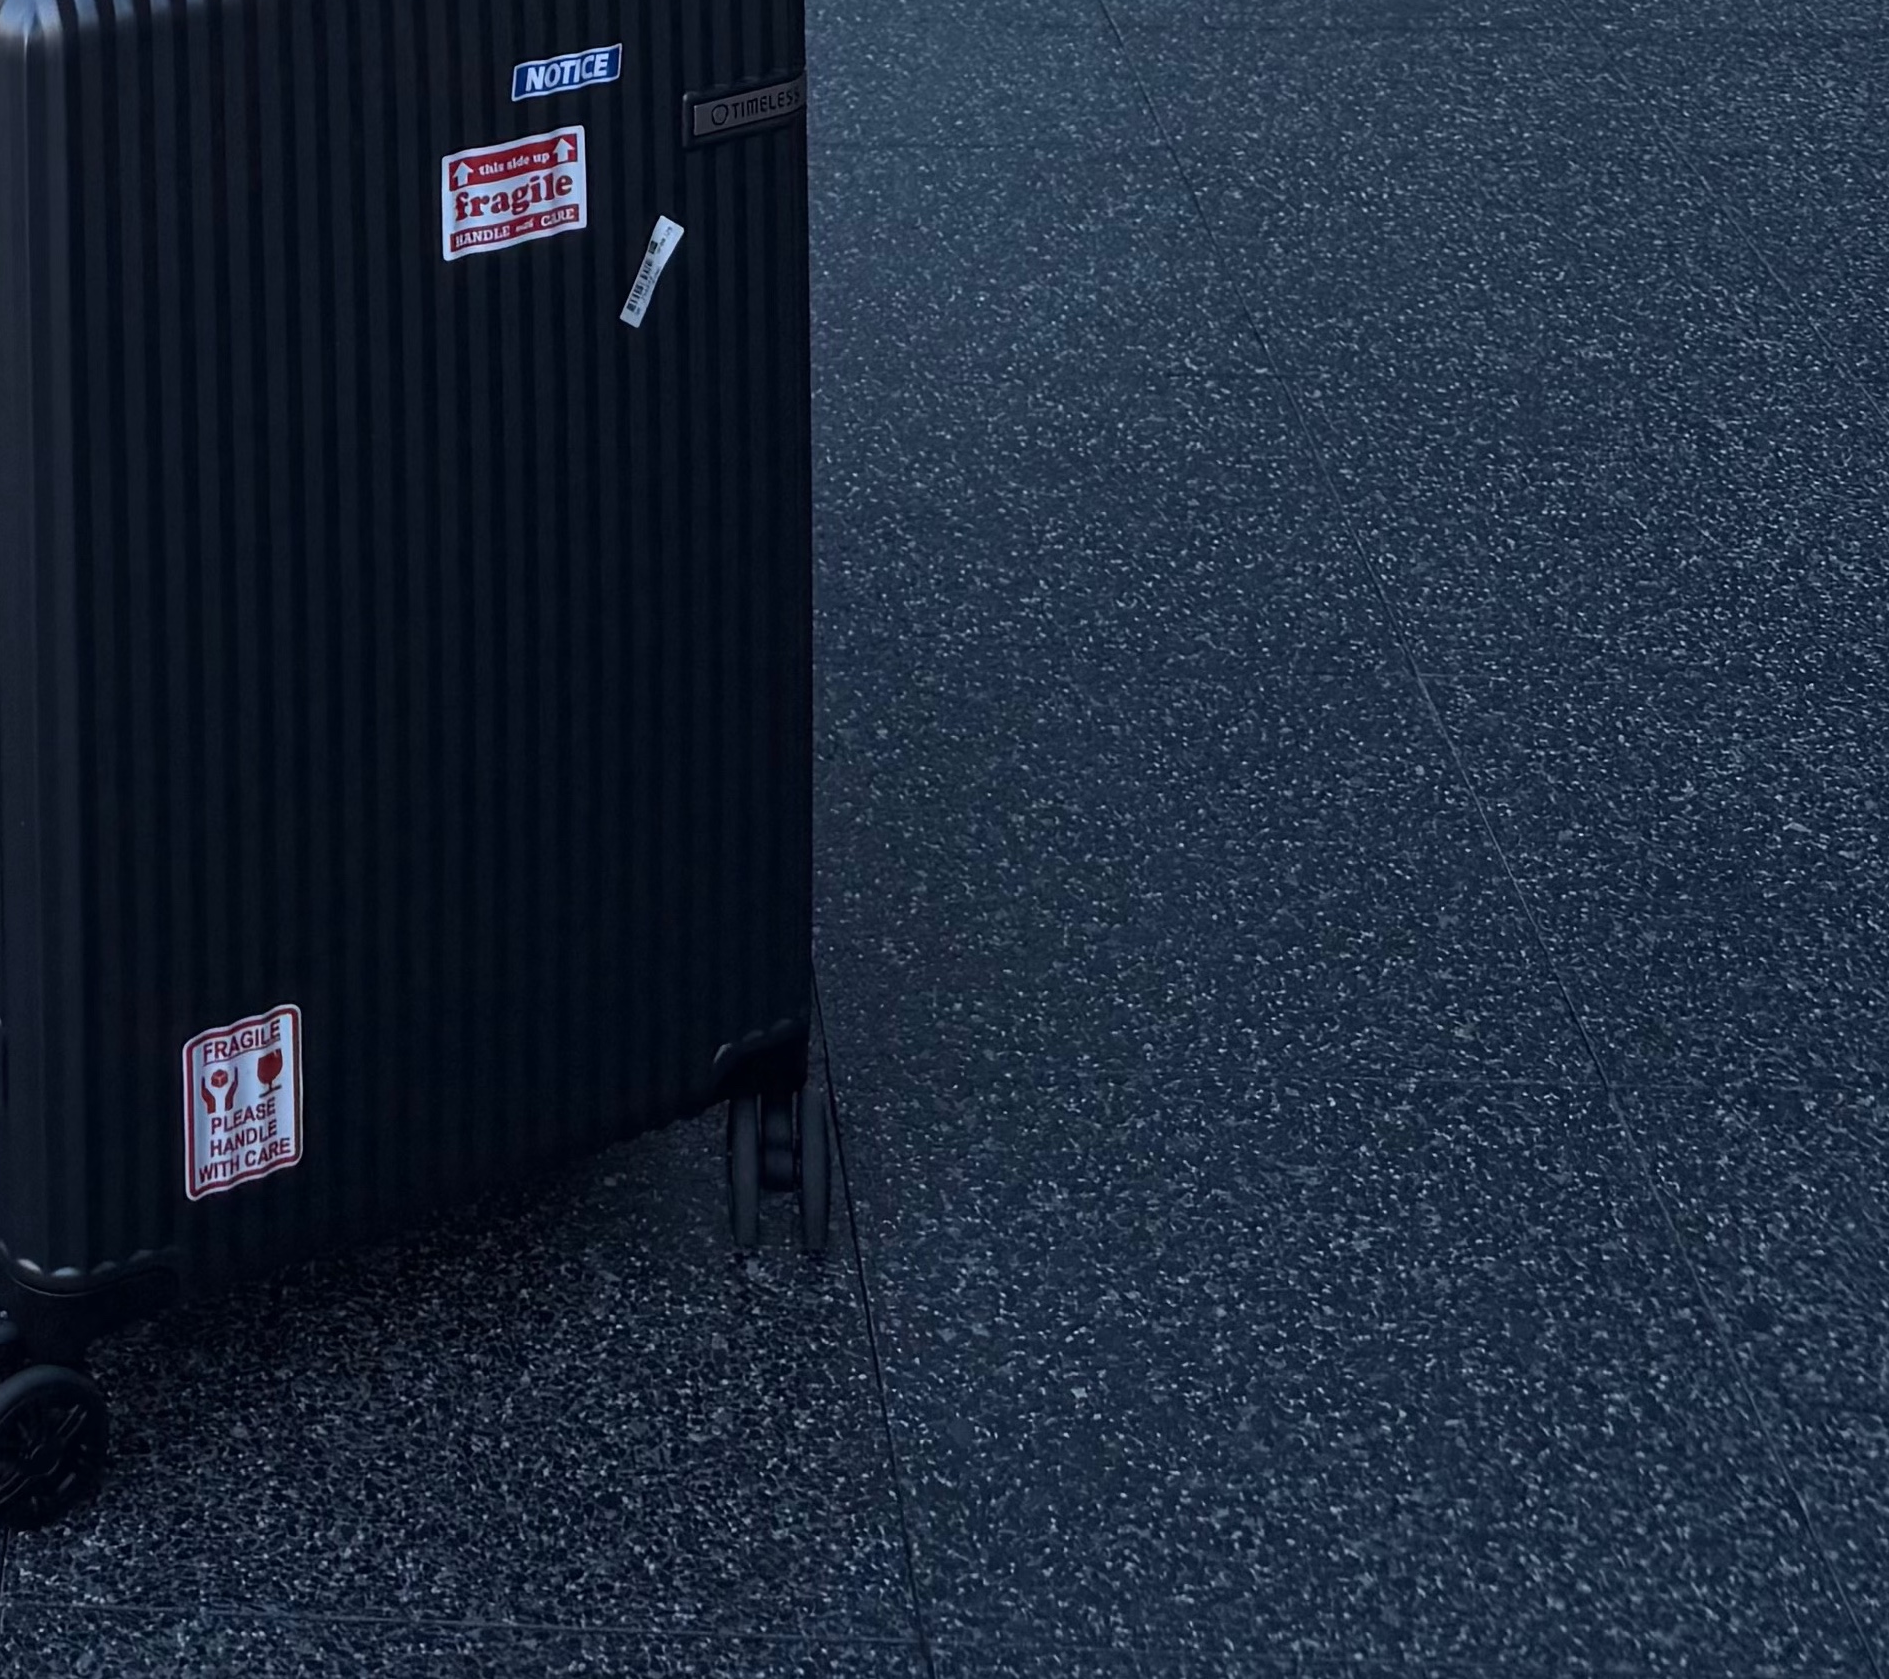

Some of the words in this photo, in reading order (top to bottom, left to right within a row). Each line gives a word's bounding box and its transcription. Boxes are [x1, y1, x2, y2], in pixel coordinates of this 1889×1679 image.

[525, 52, 609, 92] NOTICE
[479, 162, 504, 176] this
[507, 155, 529, 169] side
[533, 152, 550, 165] up
[455, 172, 573, 223] fragile
[455, 225, 510, 248] HANDLE
[541, 207, 575, 227] CARE
[203, 1018, 281, 1063] FRAGILE
[211, 1097, 276, 1135] PLEASE
[210, 1119, 277, 1158] HANDLE
[199, 1154, 239, 1184] WITH
[245, 1137, 290, 1167] CARE
